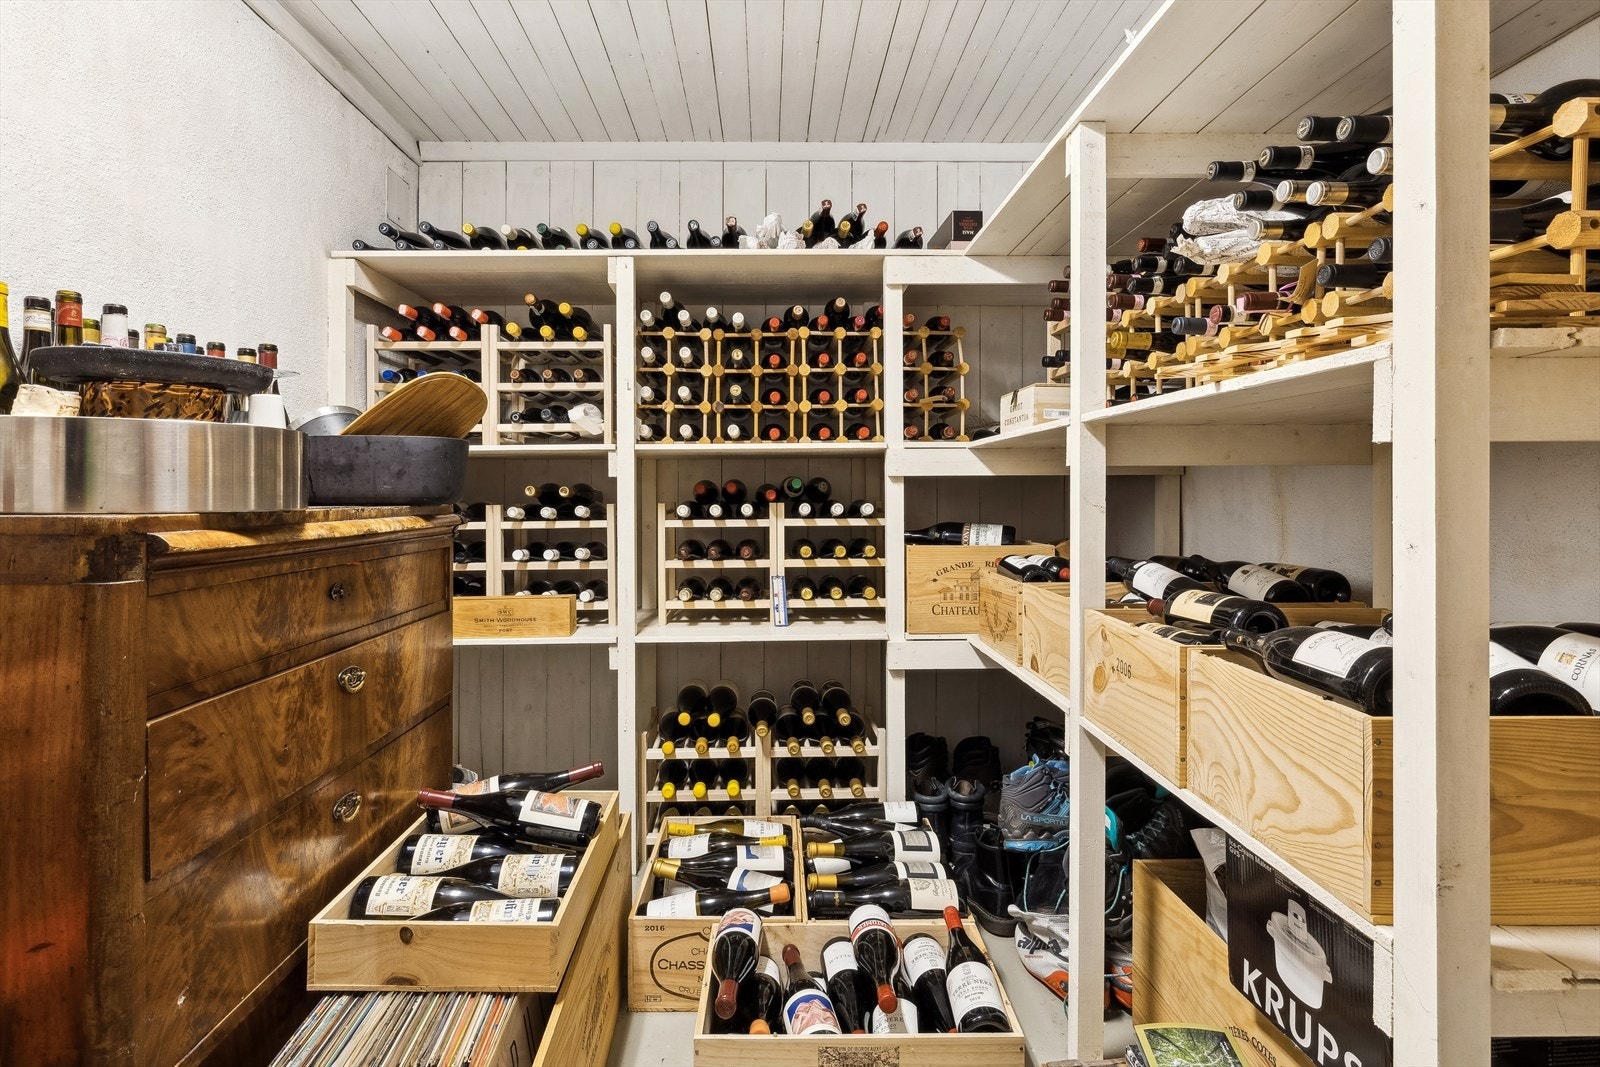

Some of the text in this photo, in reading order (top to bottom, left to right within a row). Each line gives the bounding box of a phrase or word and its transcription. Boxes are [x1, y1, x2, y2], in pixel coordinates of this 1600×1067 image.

[935, 560, 974, 577] GRANDE
[931, 604, 980, 616] CHATEAU
[1116, 657, 1132, 679] 2006
[1571, 647, 1597, 681] CORNAS
[1020, 813, 1032, 821] LA
[657, 958, 705, 970] CHASS
[678, 986, 695, 995] CRU
